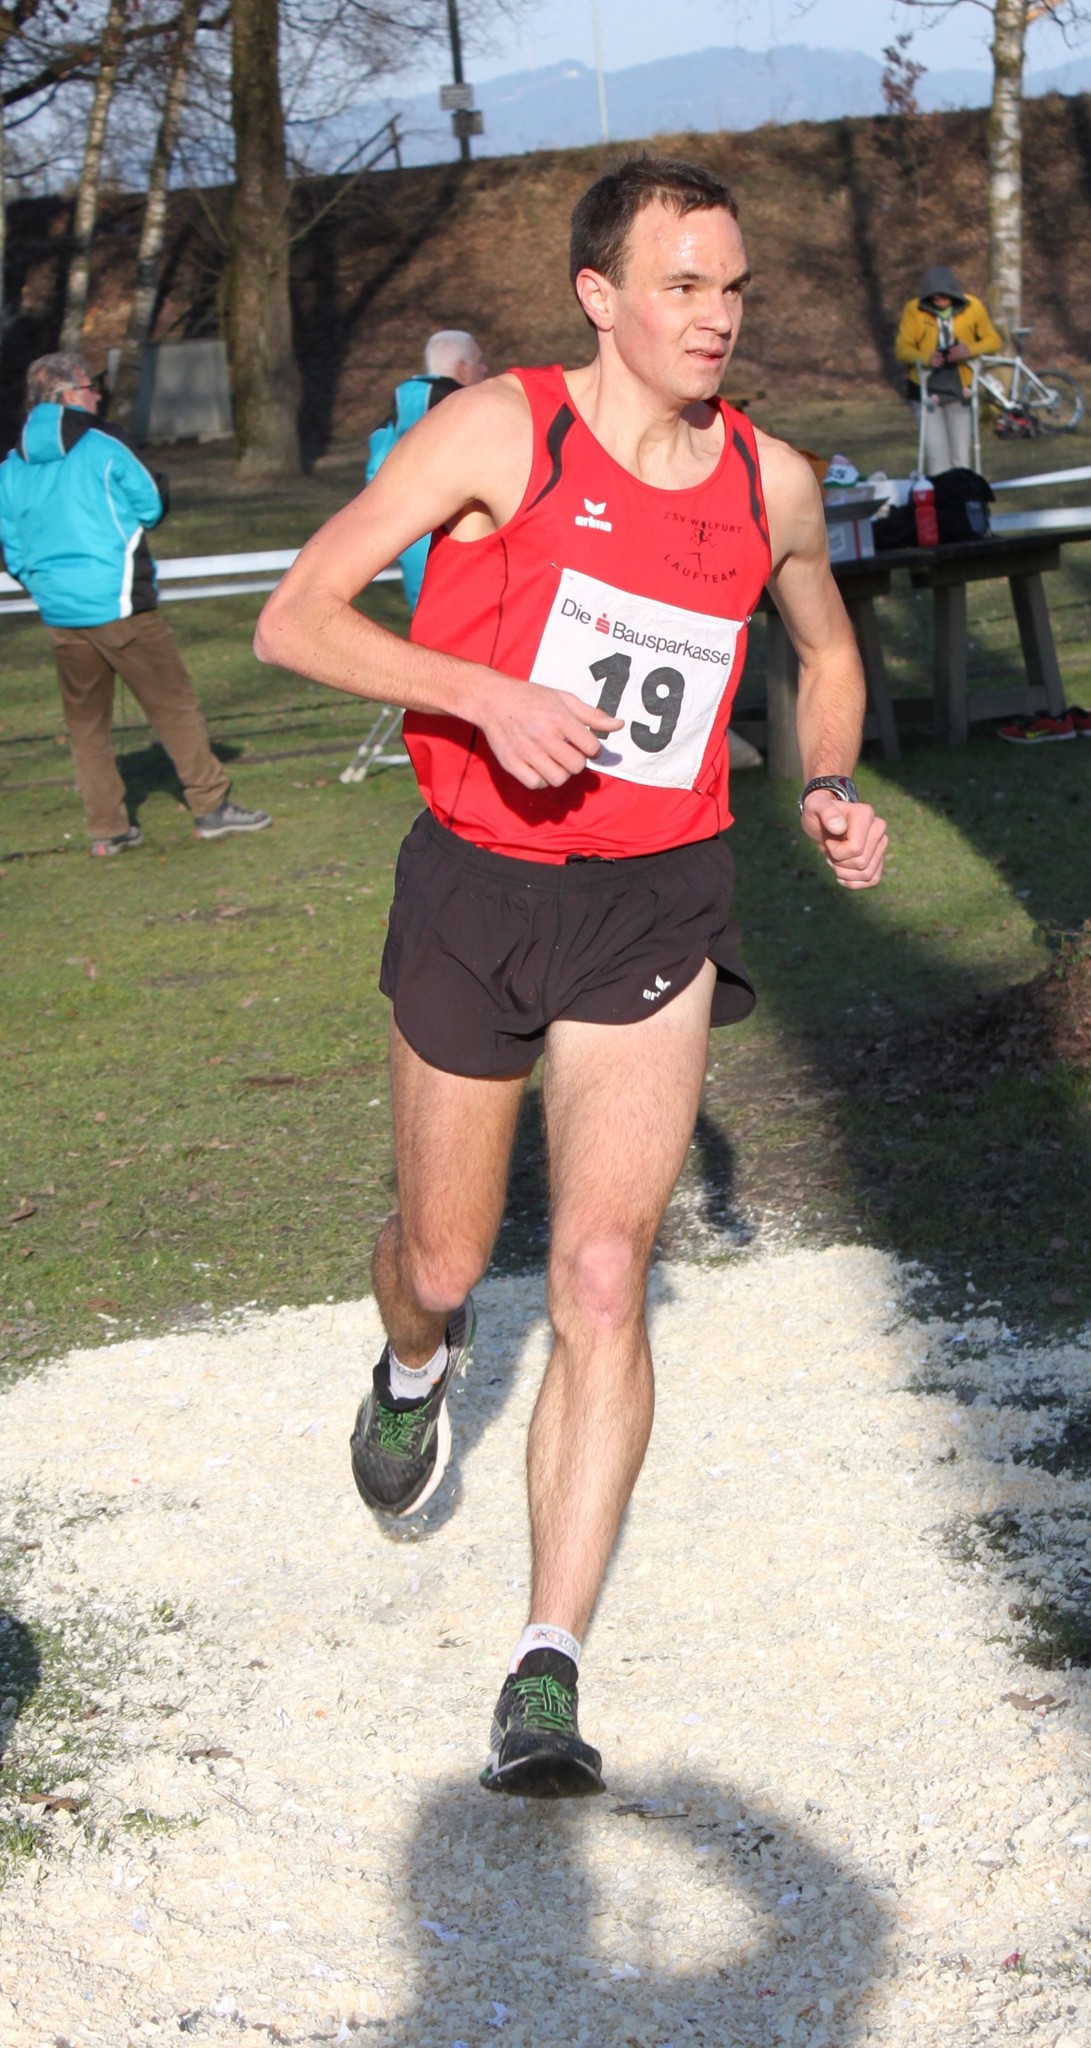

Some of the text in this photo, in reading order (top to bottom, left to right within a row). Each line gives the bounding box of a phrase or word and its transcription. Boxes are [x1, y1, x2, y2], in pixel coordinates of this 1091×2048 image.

[664, 511, 686, 522] ZSV
[664, 553, 737, 583] LAUFTEAM
[560, 598, 591, 625] Die
[612, 621, 731, 666] Bausparkasse
[588, 652, 686, 754] 19
